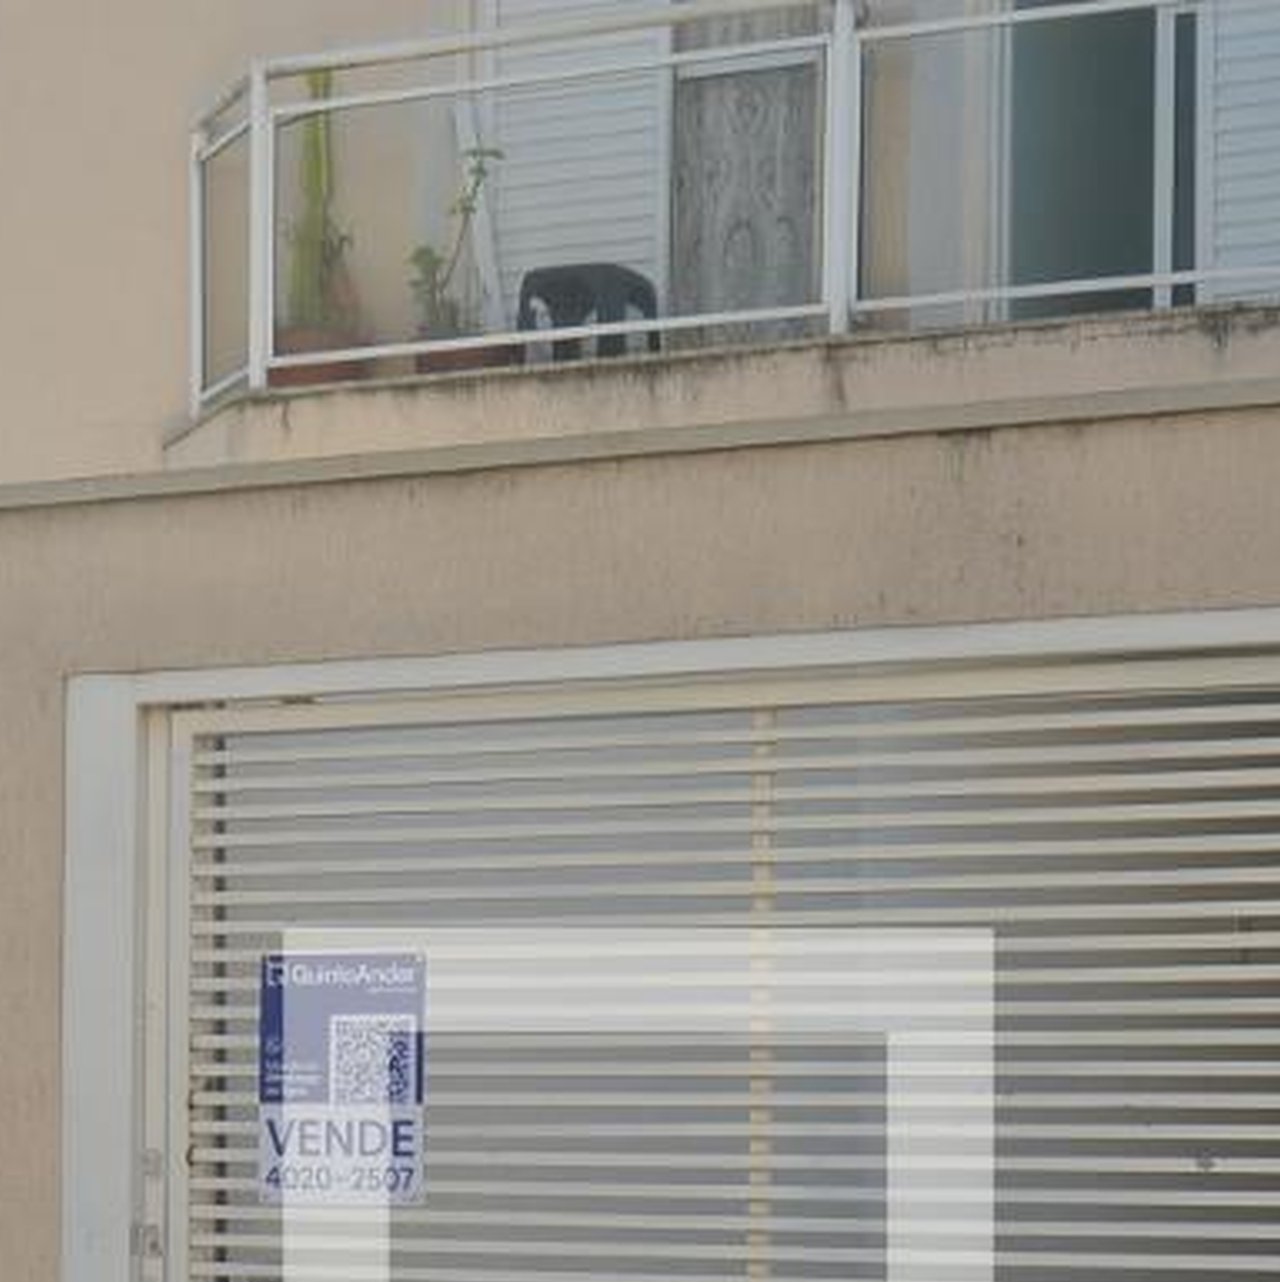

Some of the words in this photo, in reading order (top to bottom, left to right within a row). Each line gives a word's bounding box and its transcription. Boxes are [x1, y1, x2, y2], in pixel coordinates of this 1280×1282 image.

[291, 961, 415, 986] QuintoAndar
[265, 1119, 415, 1157] VENDE
[265, 1166, 415, 1191] 4020-2507
